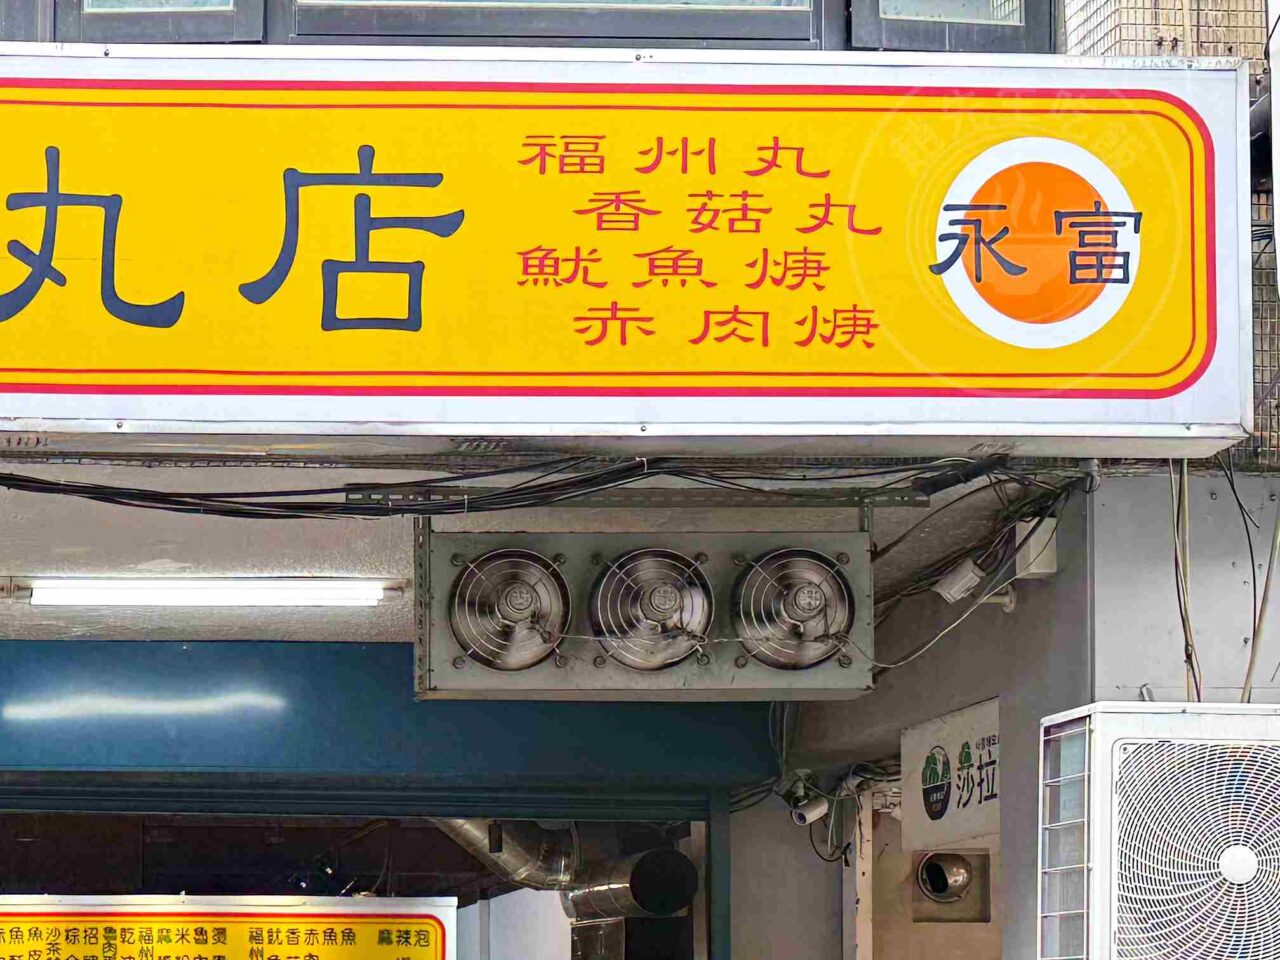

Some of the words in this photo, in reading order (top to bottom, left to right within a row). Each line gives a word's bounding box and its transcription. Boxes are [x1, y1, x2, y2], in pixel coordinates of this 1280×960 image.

[518, 135, 831, 179] 福州丸
[573, 190, 882, 236] 香菇丸
[928, 200, 1143, 285] 永富
[517, 245, 831, 292] 魷魚焿
[573, 301, 880, 349] 赤肉焿
